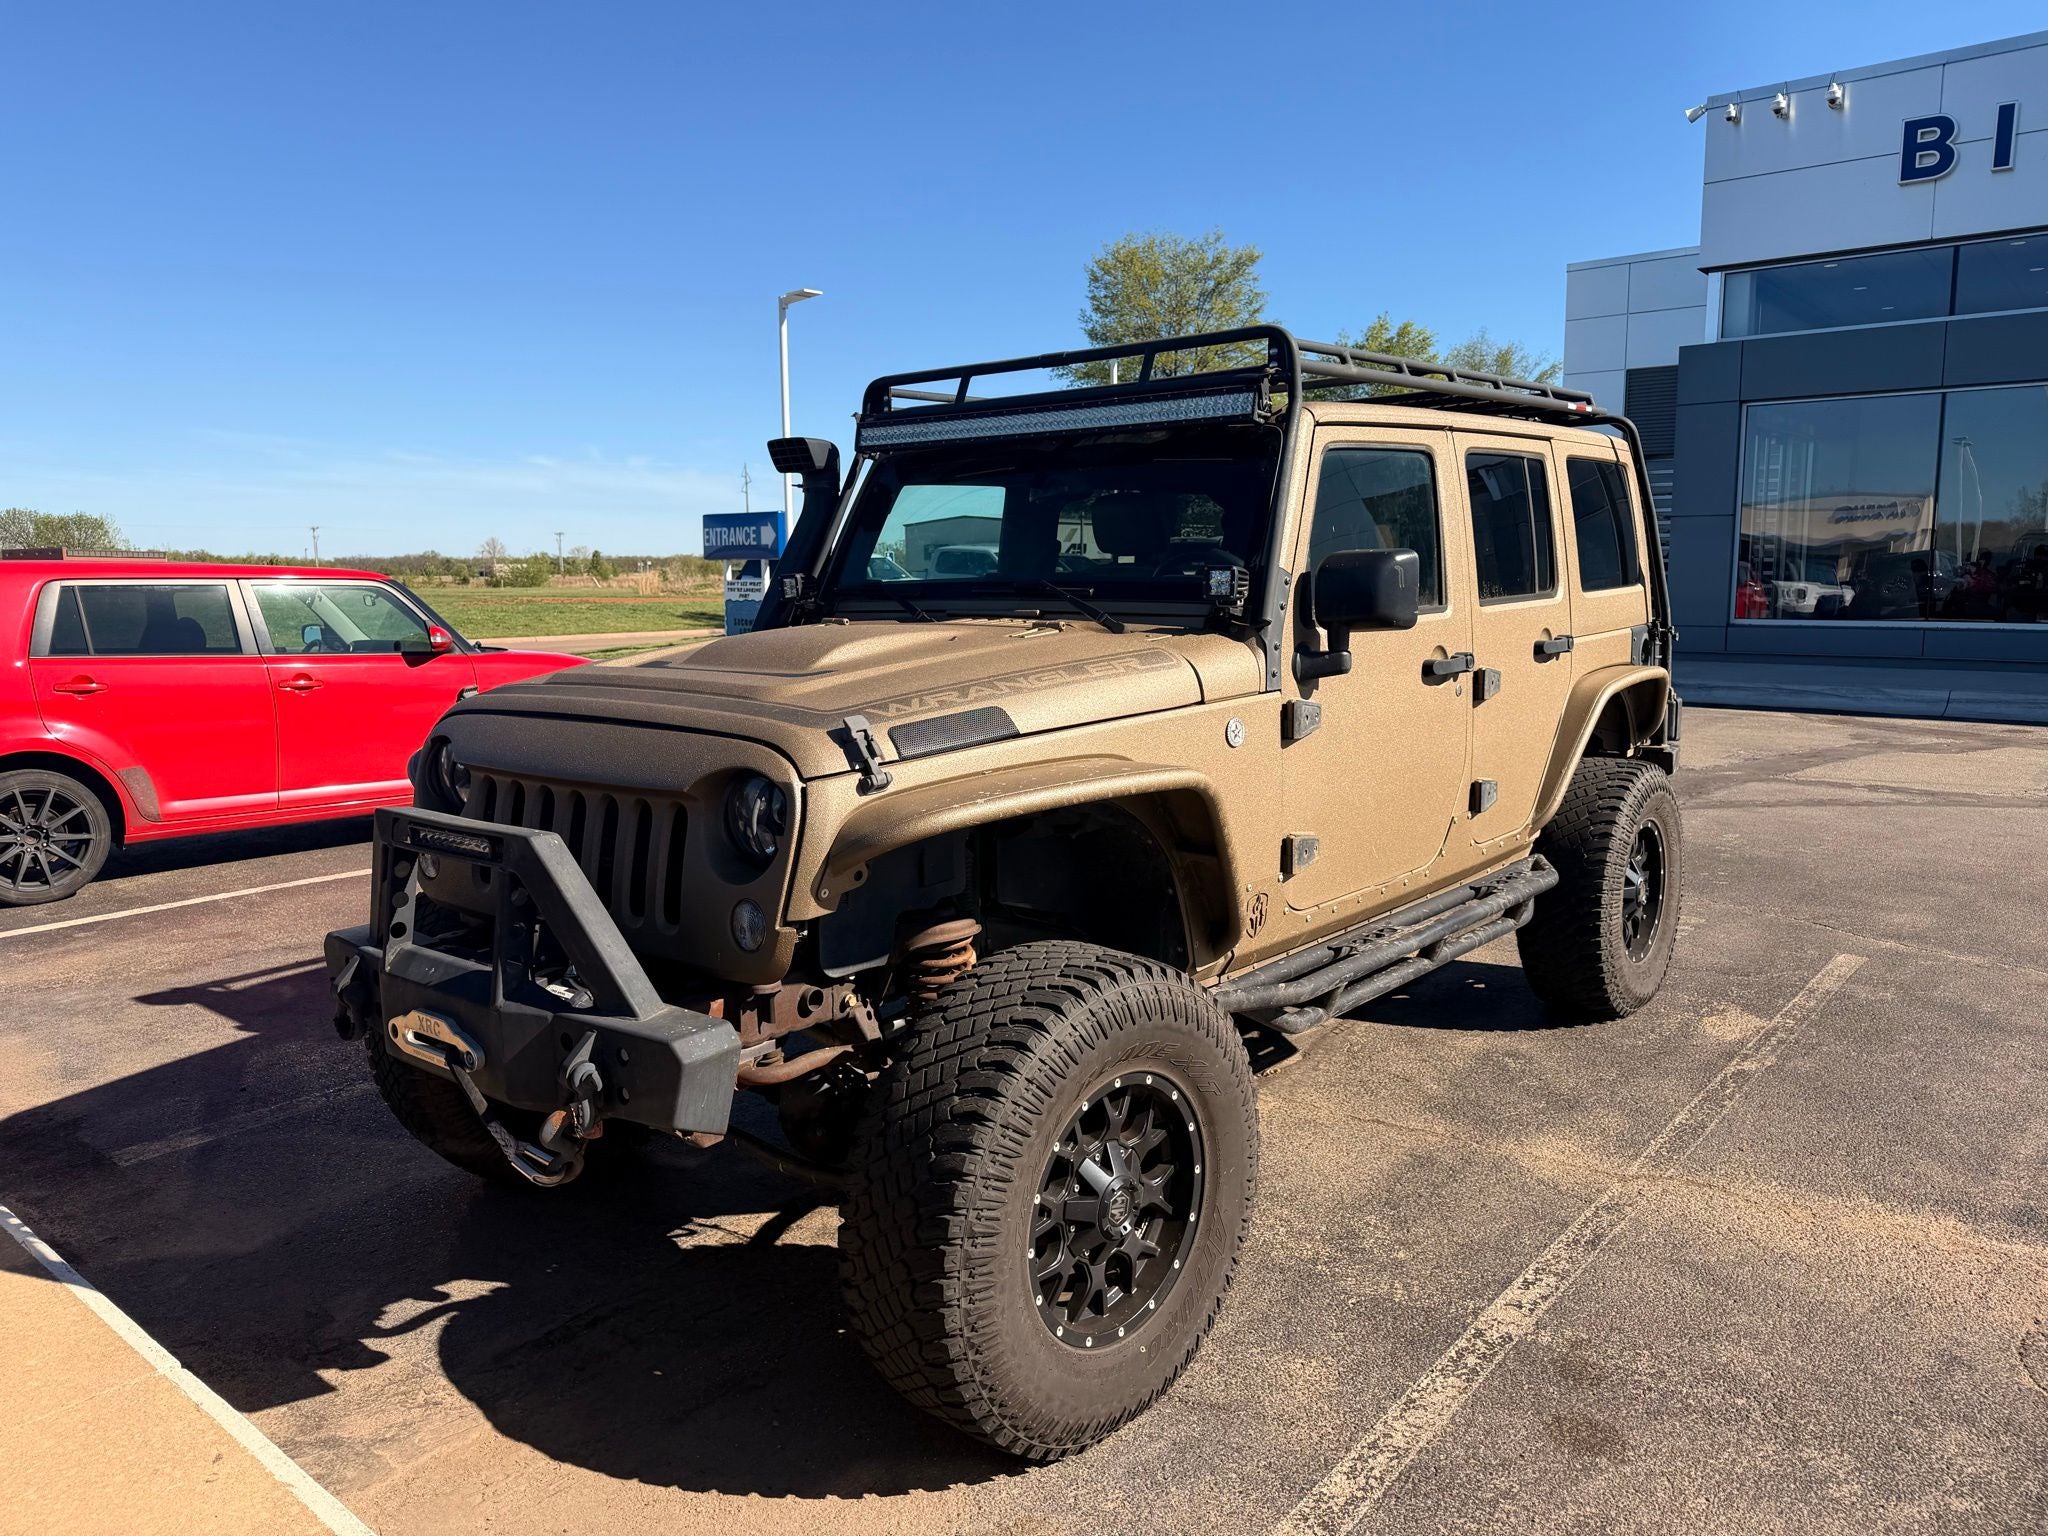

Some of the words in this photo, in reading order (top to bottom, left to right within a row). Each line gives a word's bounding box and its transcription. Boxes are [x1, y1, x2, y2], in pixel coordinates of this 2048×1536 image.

[704, 526, 757, 546] ENTRANCE
[864, 657, 1144, 717] WRANGLER
[417, 1015, 441, 1036] XRC
